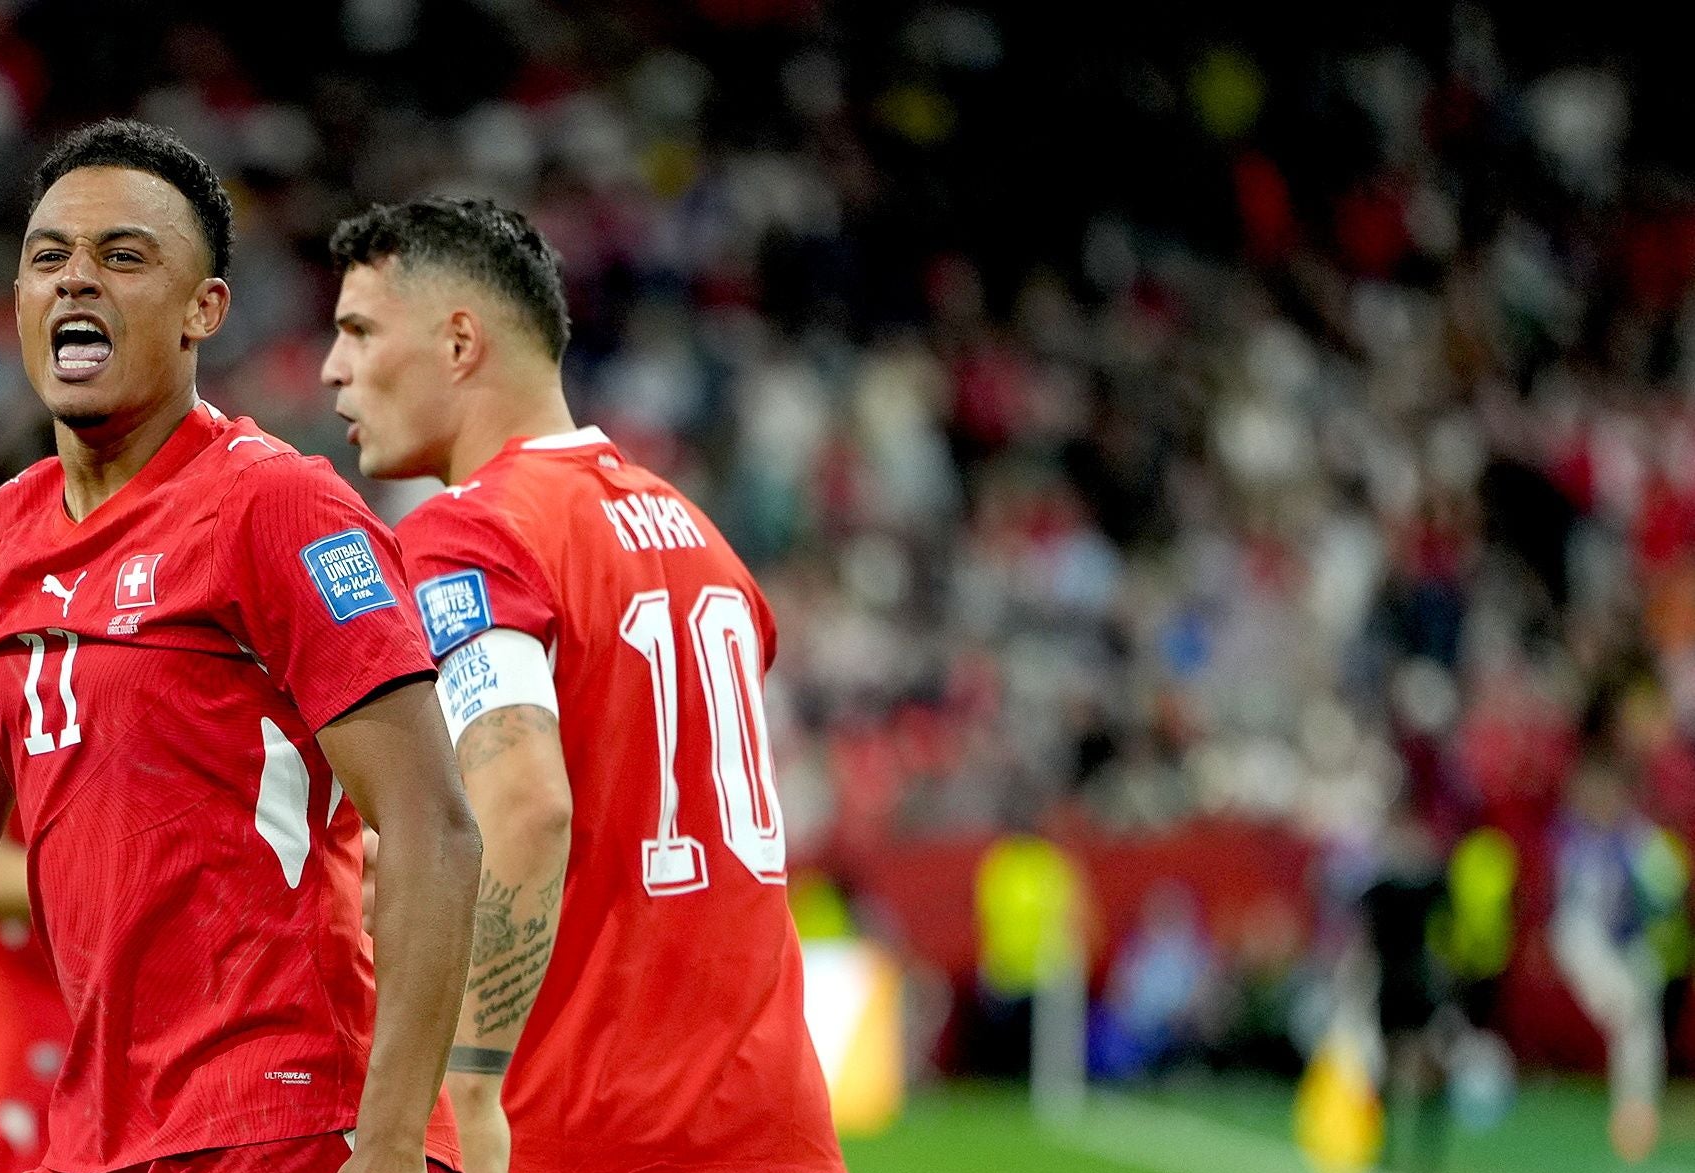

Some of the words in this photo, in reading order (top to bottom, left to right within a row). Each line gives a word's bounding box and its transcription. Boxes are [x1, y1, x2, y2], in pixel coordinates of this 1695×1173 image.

[318, 541, 366, 567] FOOTBALL
[324, 552, 375, 582] UNITES
[331, 581, 352, 598] the
[349, 569, 383, 590] World
[352, 589, 374, 600] FIFA
[426, 580, 473, 603] FOOTBALL
[428, 591, 476, 620] UNITES
[17, 627, 82, 756] 11
[445, 654, 490, 701] UNITES
[460, 672, 499, 705] World
[619, 586, 787, 897] 10
